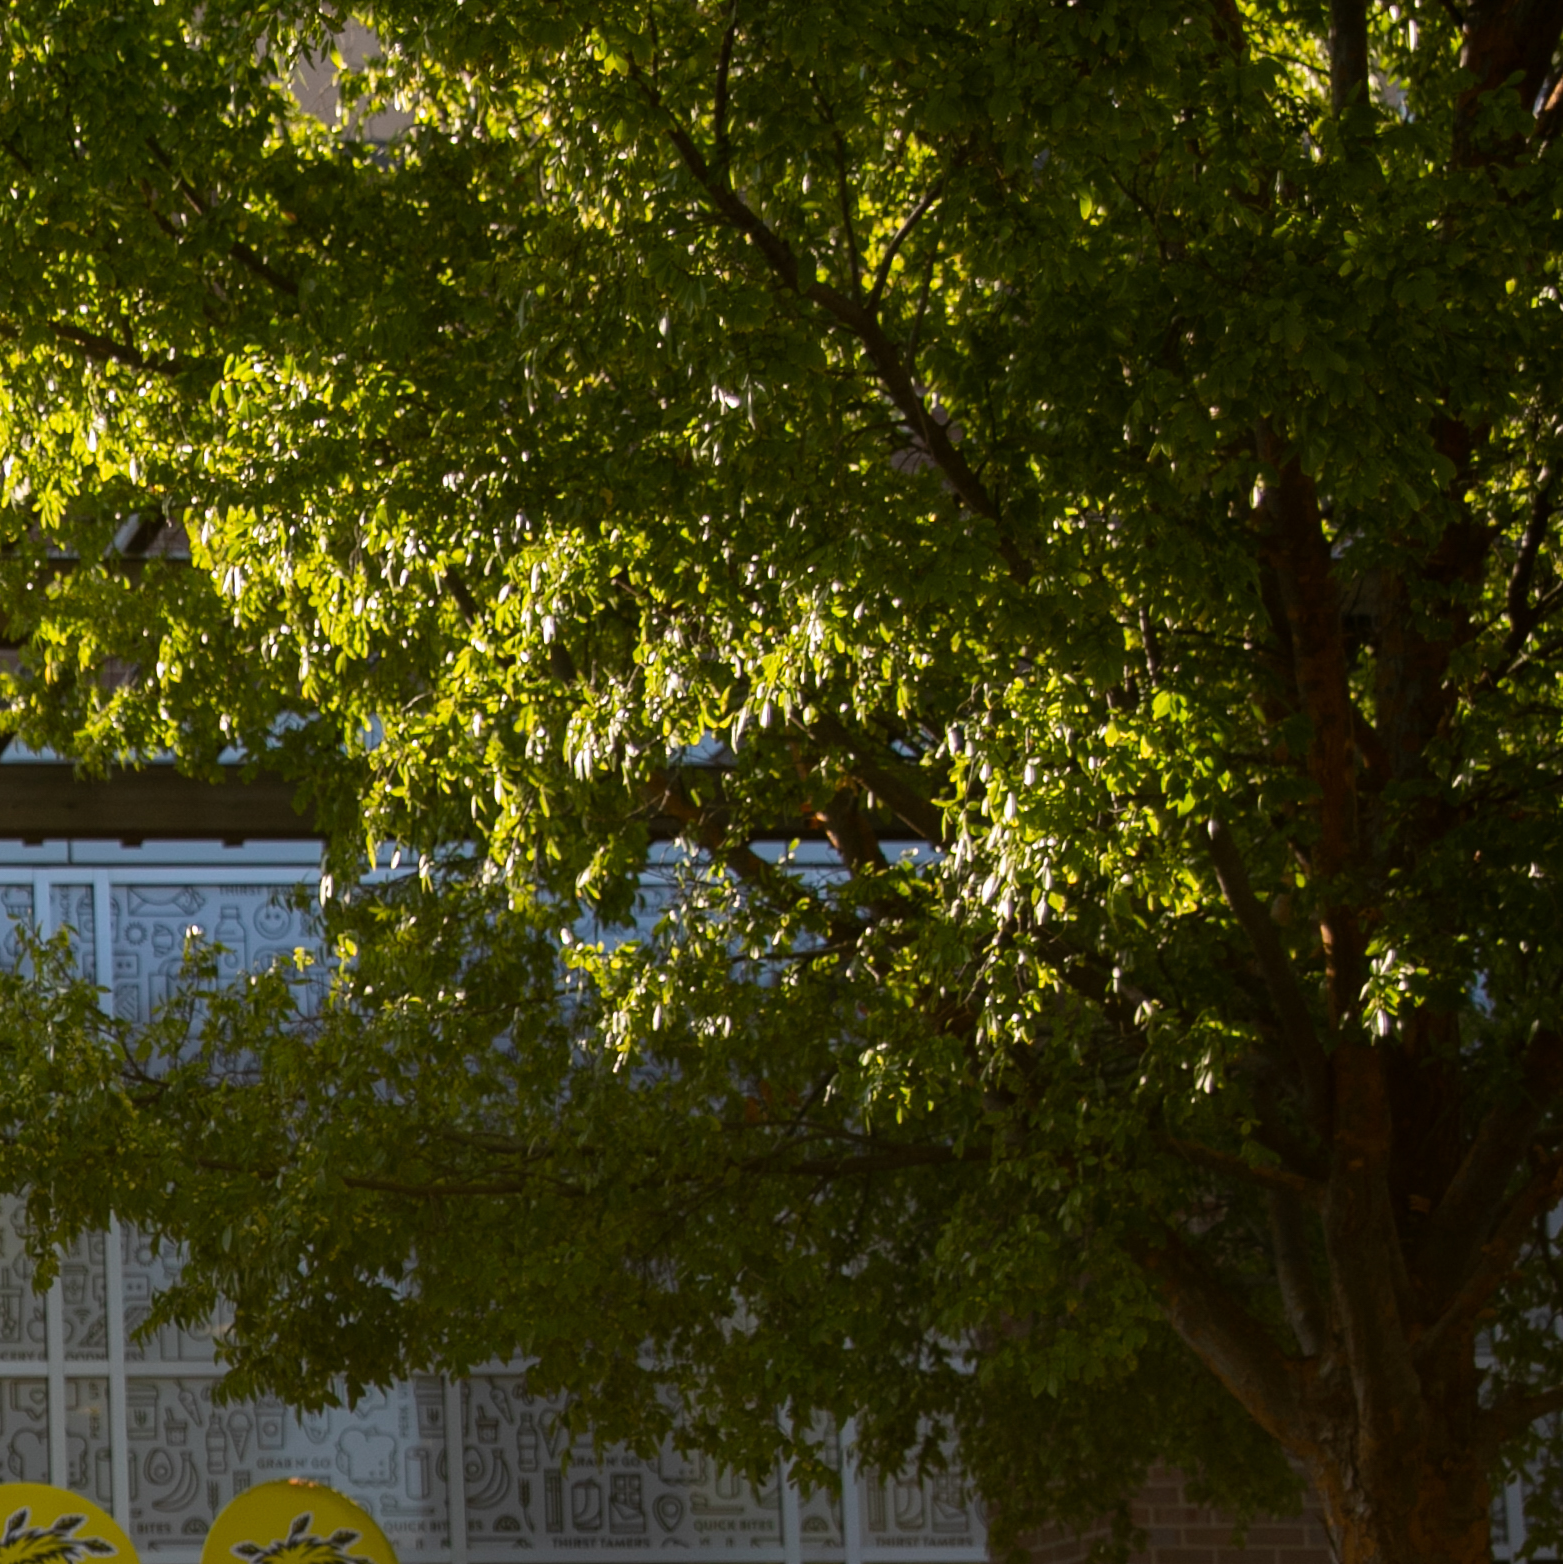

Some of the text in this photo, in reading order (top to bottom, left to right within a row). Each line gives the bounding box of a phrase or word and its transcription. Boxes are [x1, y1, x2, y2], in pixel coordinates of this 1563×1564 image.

[256, 1457, 292, 1469] GRAB
[310, 1457, 331, 1469] GO
[137, 1522, 171, 1534] BITES
[383, 1521, 424, 1533] QUICK
[693, 1519, 774, 1532] QUICK BITES
[553, 1537, 650, 1548] THIRST TAMERS
[876, 1537, 973, 1548] THIRST TAMERS
